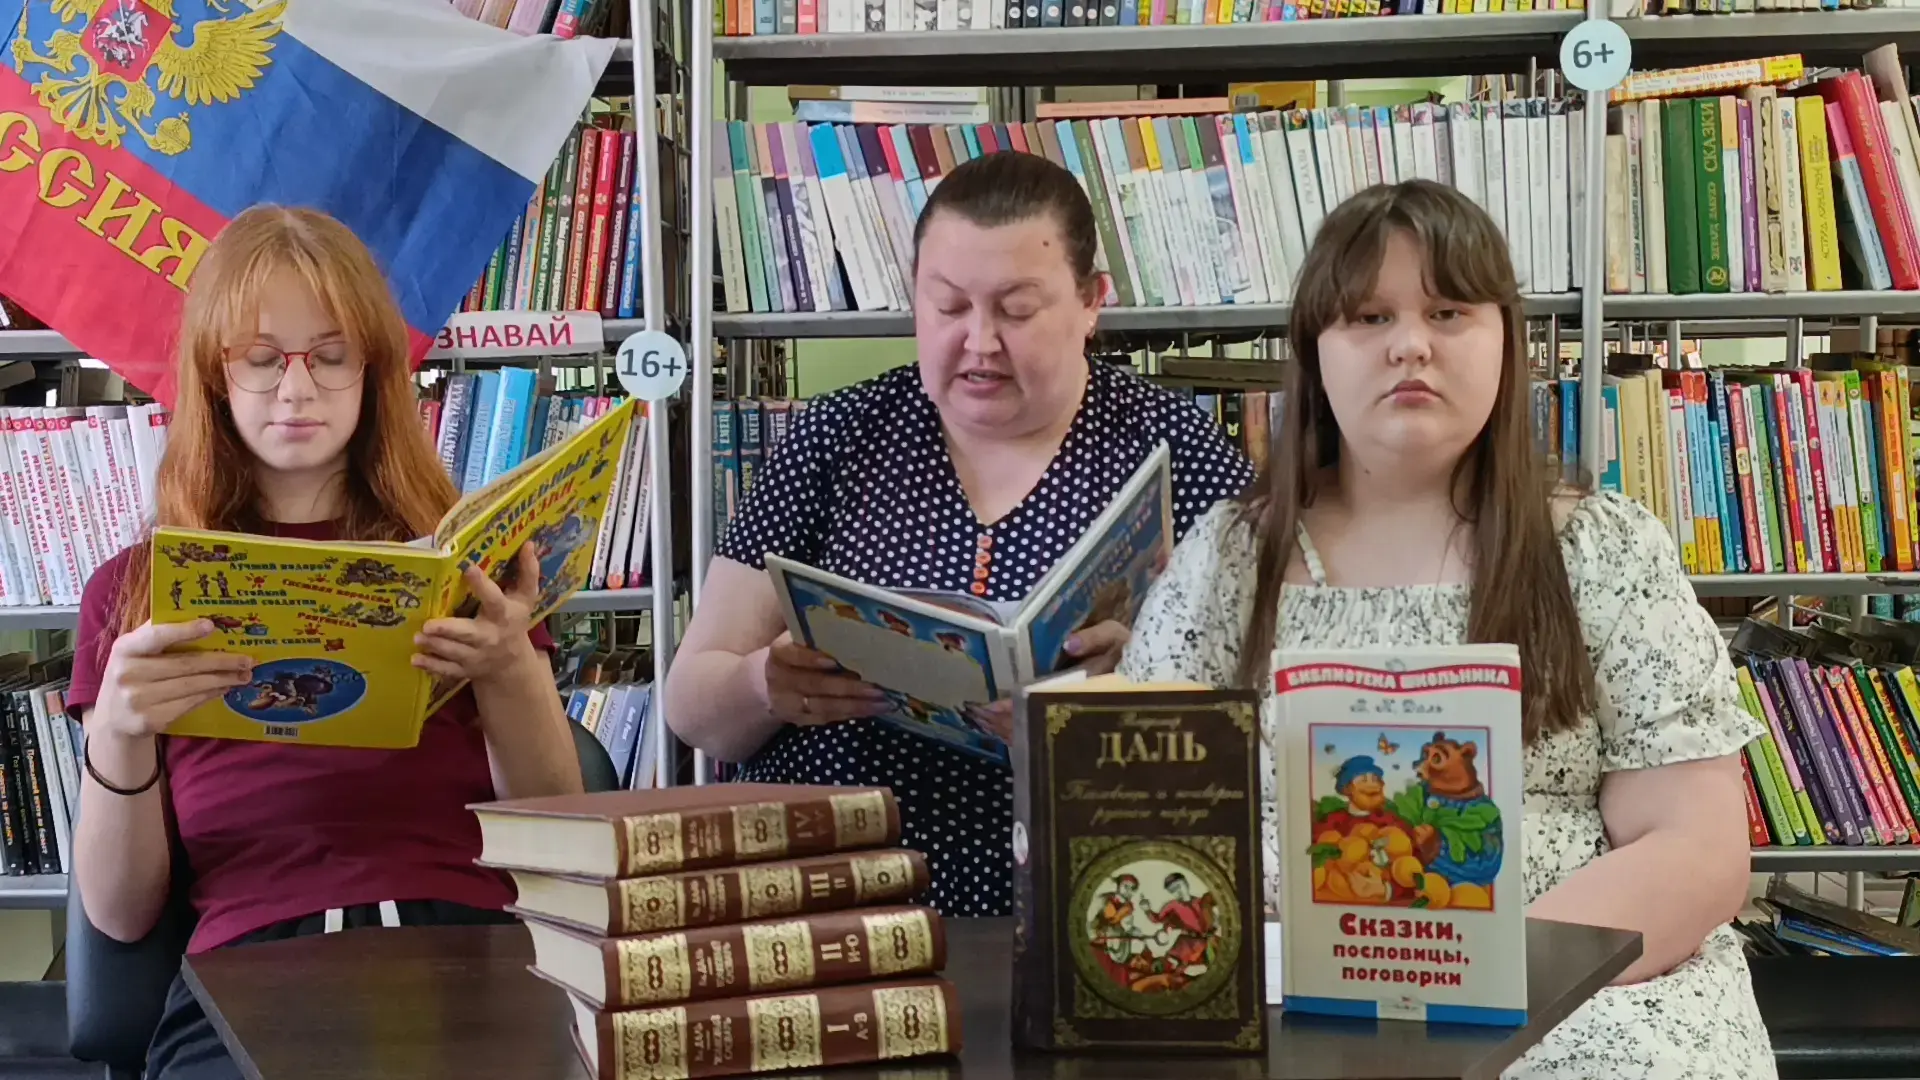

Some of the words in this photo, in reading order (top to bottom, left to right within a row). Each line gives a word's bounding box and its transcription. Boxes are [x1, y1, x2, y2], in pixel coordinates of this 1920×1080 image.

[1572, 39, 1615, 69] 6+
[1700, 101, 1719, 173] СКАЗКИ
[0, 112, 212, 294] ССИЯ
[438, 314, 574, 350] ЗНАВАЙ
[620, 348, 682, 379] 16+
[450, 383, 465, 415] УРАЛА
[39, 436, 59, 491] ПИСАТЕЛЕЙ
[442, 419, 459, 477] ТЕРАТУРЕ
[21, 449, 37, 494] КОМАНДА
[32, 454, 50, 504] ПИТОМЦЫ
[58, 464, 74, 511] ТОЛСТЯКА
[2, 470, 20, 526] РАССКАЗЫ
[31, 496, 42, 512] ЕГО
[76, 495, 90, 530] ЧТЕНИЕ
[499, 475, 578, 548] СКАЗКИ
[53, 494, 69, 539] РУССКИХ
[69, 515, 80, 533] ТРИ
[38, 523, 50, 554] ТИМУР
[63, 542, 81, 596] РАССКАЗЫ
[1286, 666, 1398, 690] БИБЛИОТЕКА
[1399, 667, 1511, 690] ШКОЛЬНИКА
[1095, 730, 1209, 771] ДАЛЬ
[794, 810, 814, 839] IV
[808, 873, 830, 898] III
[820, 943, 843, 961] II
[826, 1024, 850, 1034] I
